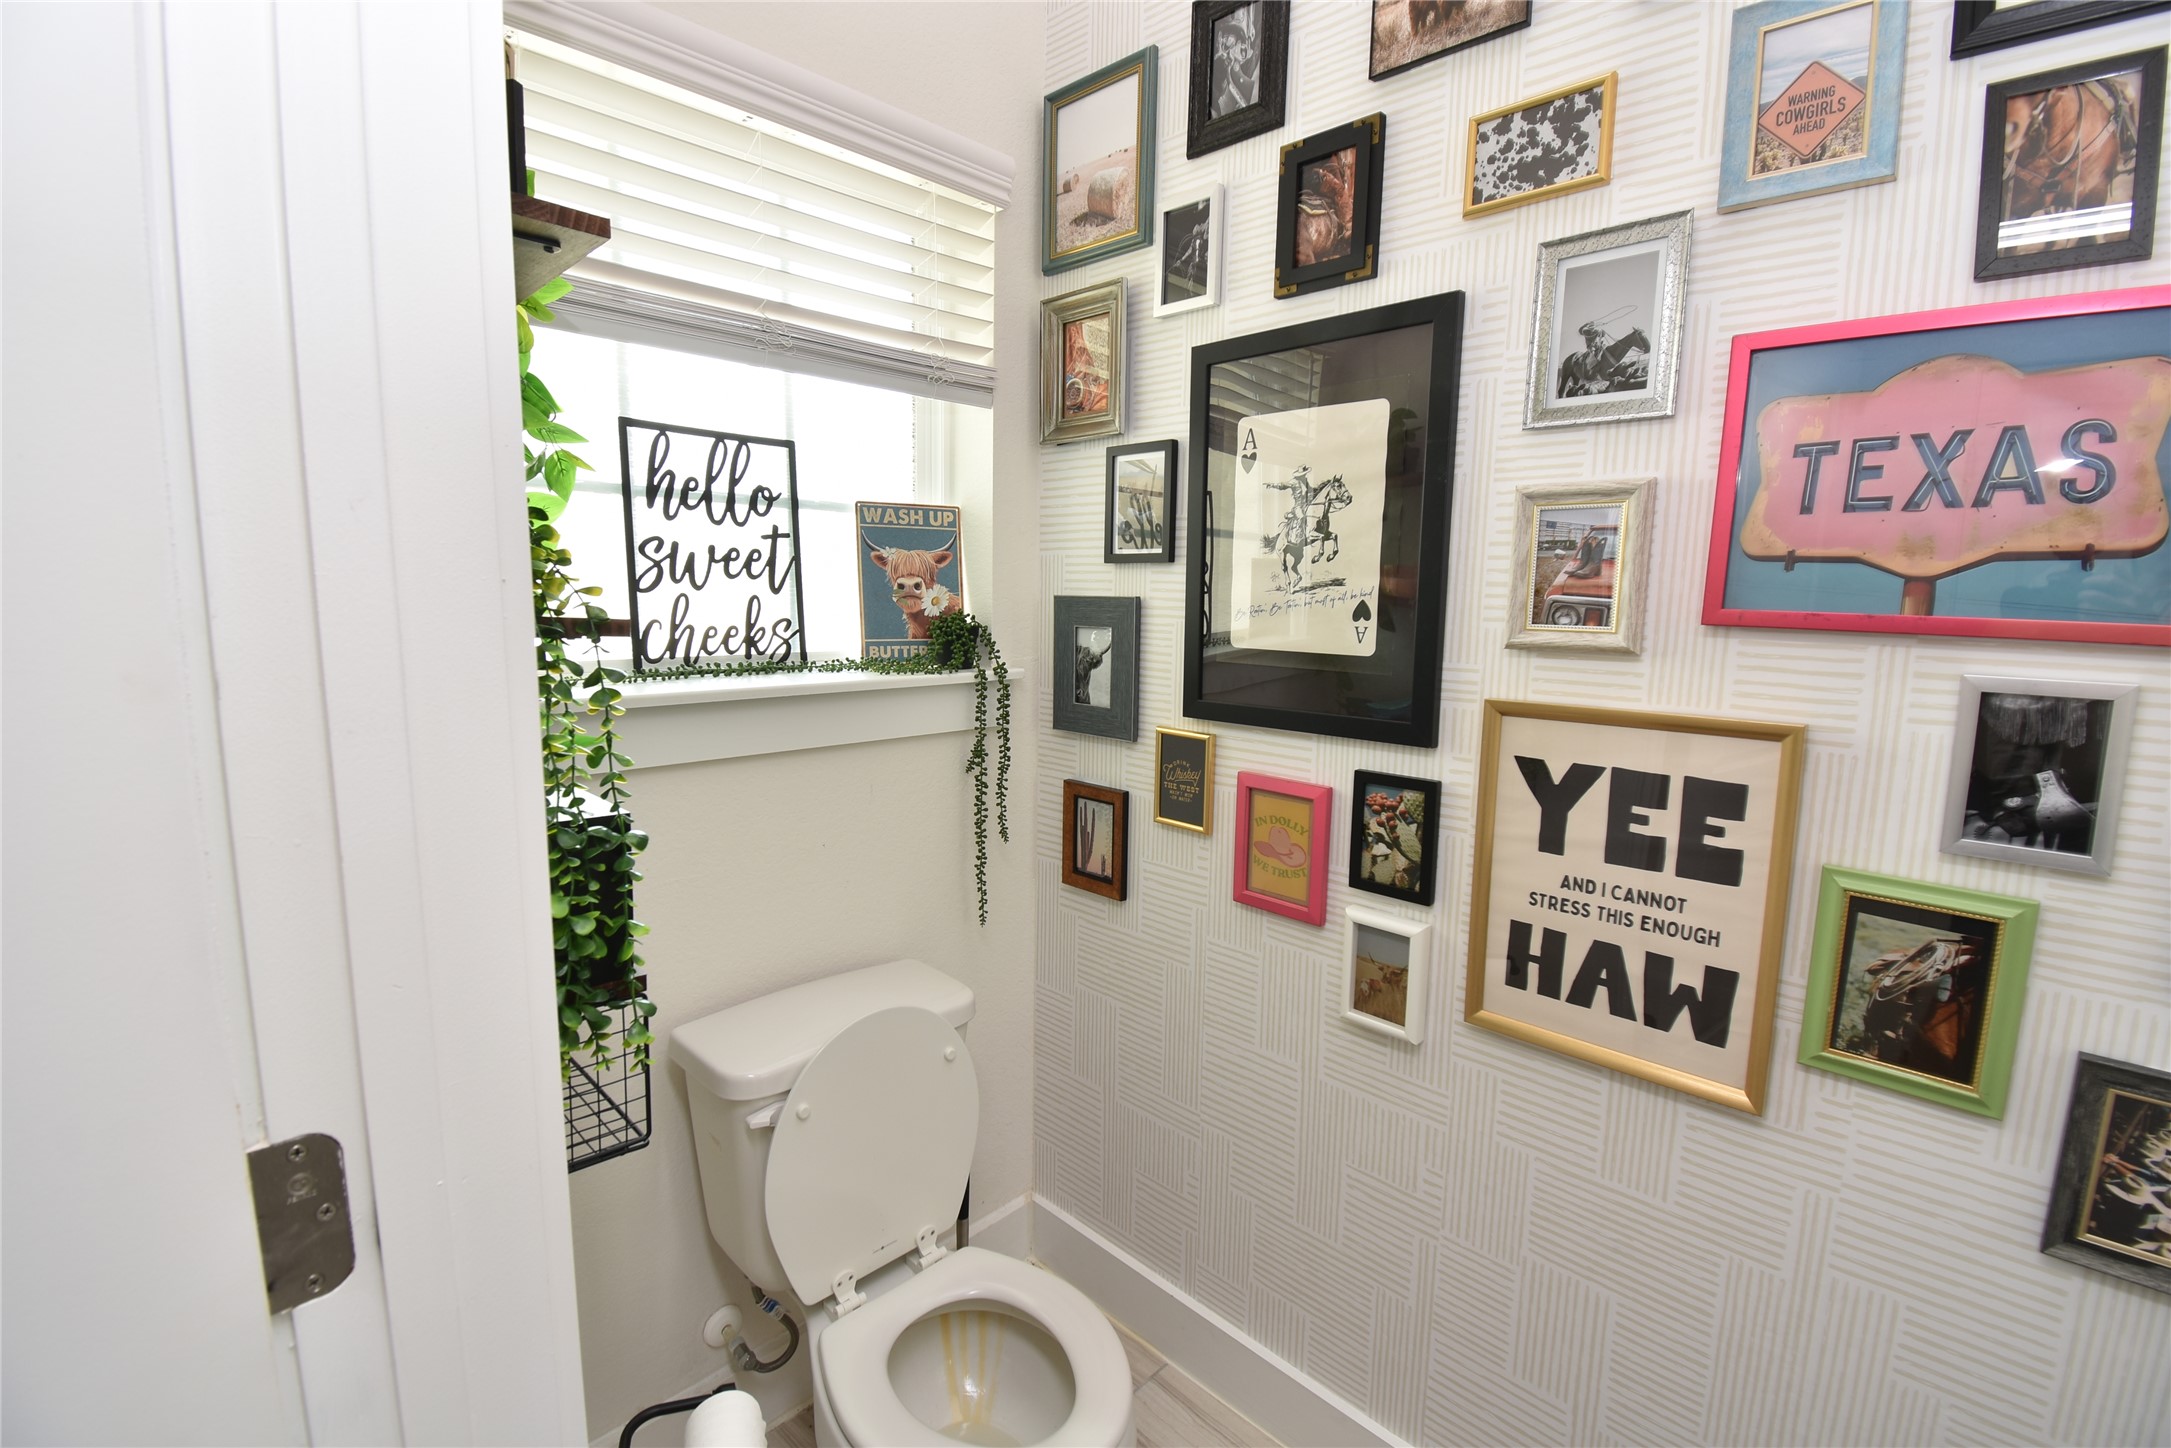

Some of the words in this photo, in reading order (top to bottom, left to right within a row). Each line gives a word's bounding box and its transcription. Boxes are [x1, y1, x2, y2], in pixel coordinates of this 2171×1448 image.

[1788, 85, 1836, 107] WARNING
[1775, 96, 1847, 127] COWGIRLS
[1792, 118, 1826, 136] AHEAD
[1241, 427, 1258, 451] A
[645, 430, 782, 528] hello
[1792, 417, 2119, 516] TEXAS
[862, 506, 924, 526] WASH
[929, 511, 954, 527] UP
[636, 524, 797, 595] sweet
[1269, 602, 1282, 617] Be
[1304, 596, 1315, 609] but
[1315, 594, 1330, 608] most
[1330, 596, 1337, 608] of
[1350, 588, 1359, 600] be
[1359, 585, 1375, 599] kind
[639, 593, 800, 666] cheeks
[1354, 625, 1369, 644] A
[869, 645, 929, 659] BUTTER
[1162, 763, 1202, 786] Whiskey
[1163, 781, 1178, 790] THE
[1179, 784, 1200, 794] WEST
[1255, 815, 1268, 827] IN
[1269, 815, 1309, 836] DOLLY
[1513, 754, 1750, 888] YEE
[1253, 854, 1269, 873] WE
[1271, 865, 1308, 879] TRUST
[1560, 873, 1597, 896] AND
[1600, 881, 1606, 898] I
[1610, 885, 1688, 914] CANNOT
[1528, 891, 1591, 919] STRESS
[1597, 905, 1634, 928] THIS
[1640, 914, 1721, 949] ENOUGH
[1505, 919, 1741, 1050] HAW
